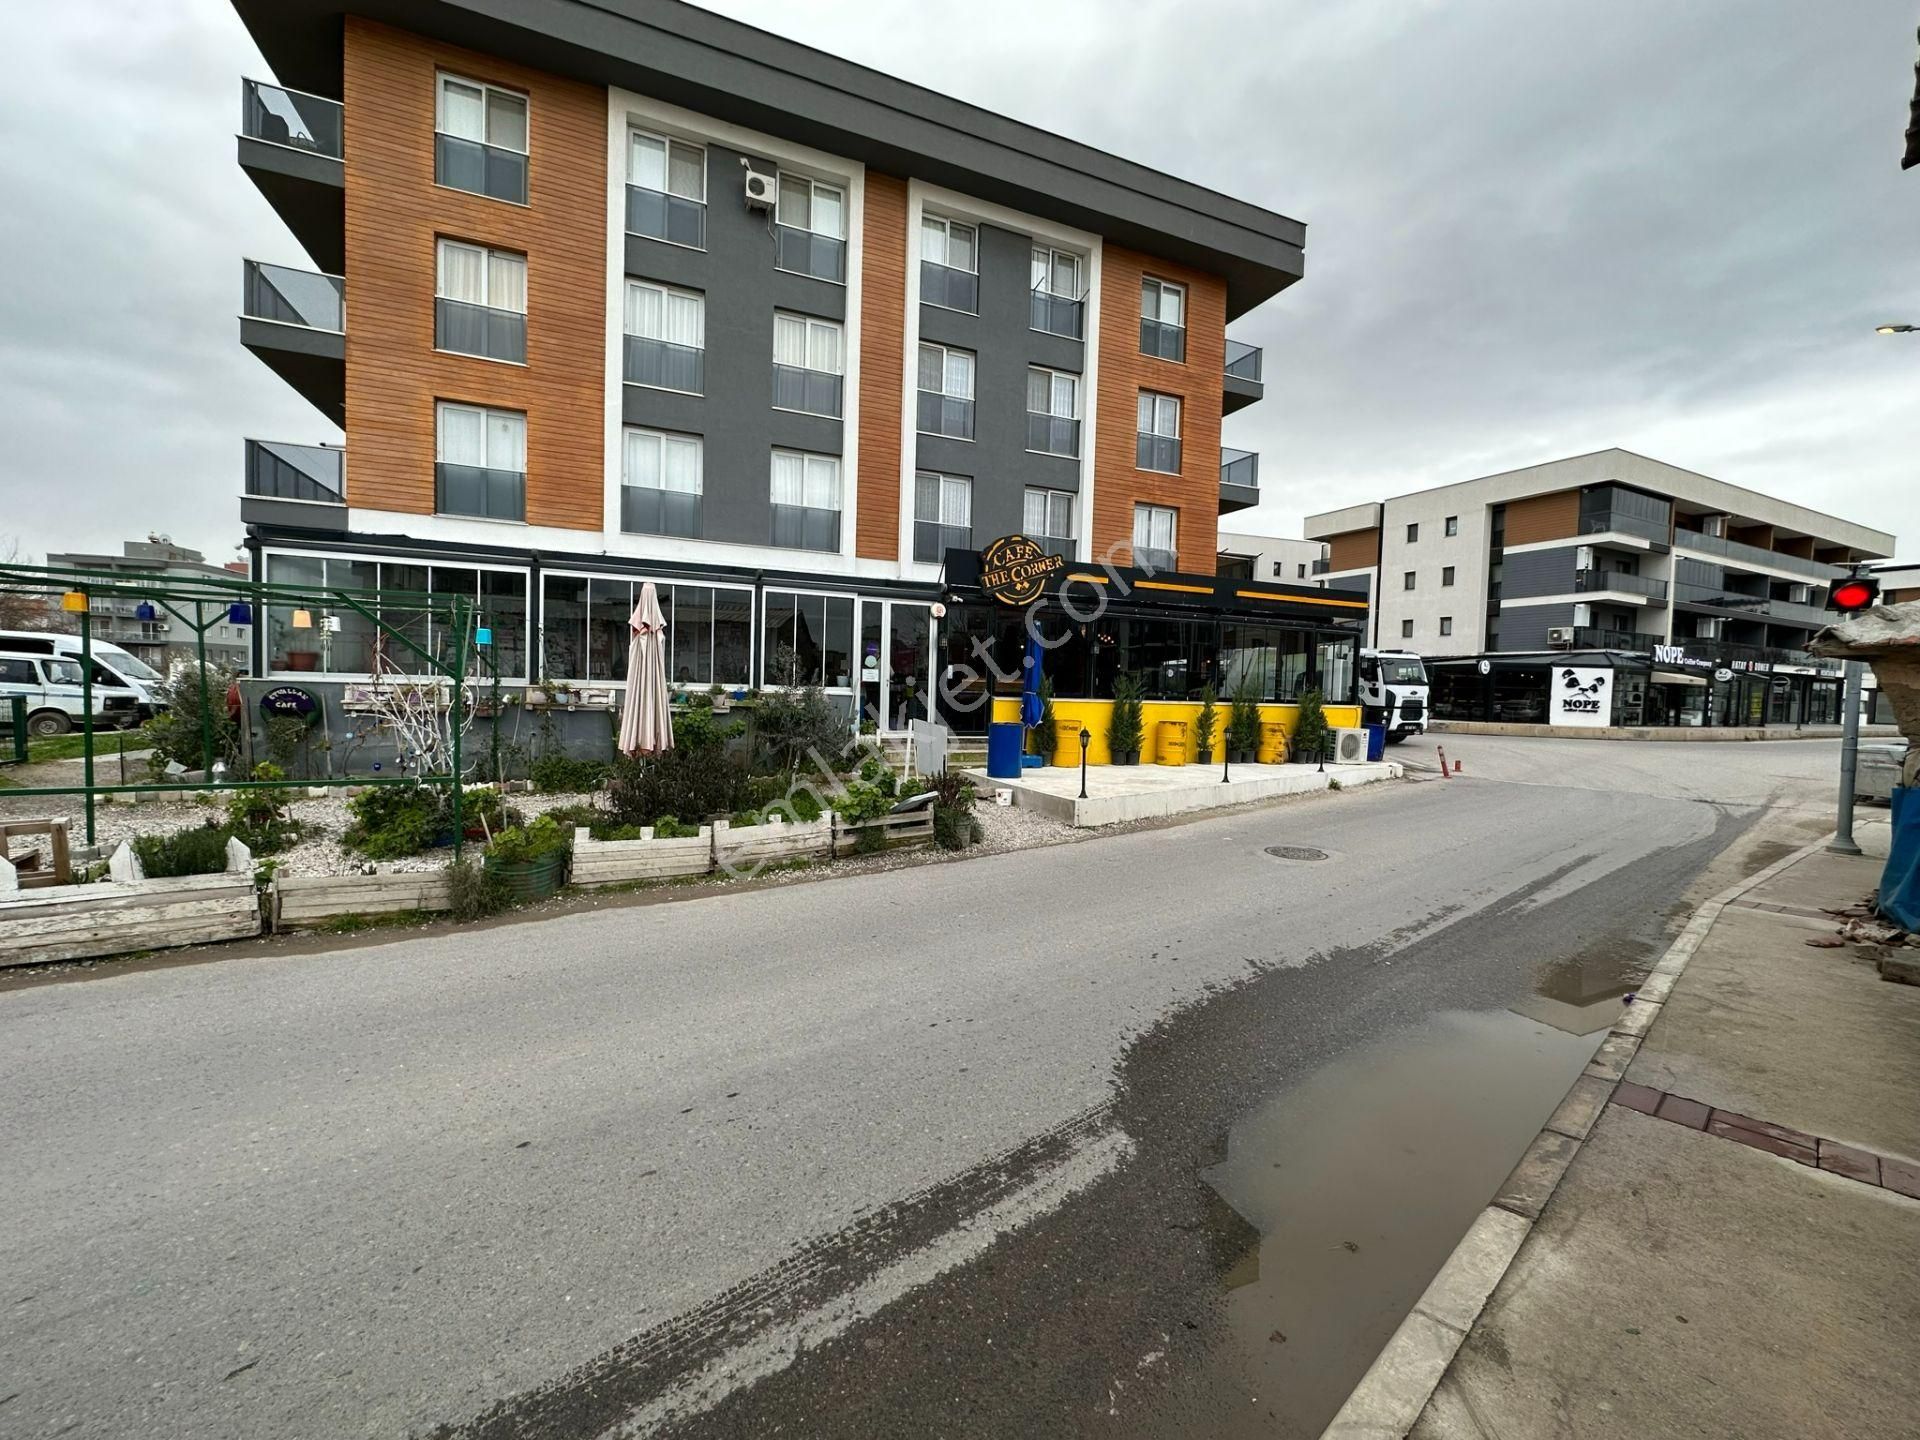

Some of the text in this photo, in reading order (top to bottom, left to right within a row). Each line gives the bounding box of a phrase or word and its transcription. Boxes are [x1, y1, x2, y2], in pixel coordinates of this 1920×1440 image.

[993, 545, 1034, 566] CAFE
[982, 556, 1065, 588] THE CORNER
[1653, 644, 1684, 665] NOPE
[1562, 699, 1601, 709] NOPE
